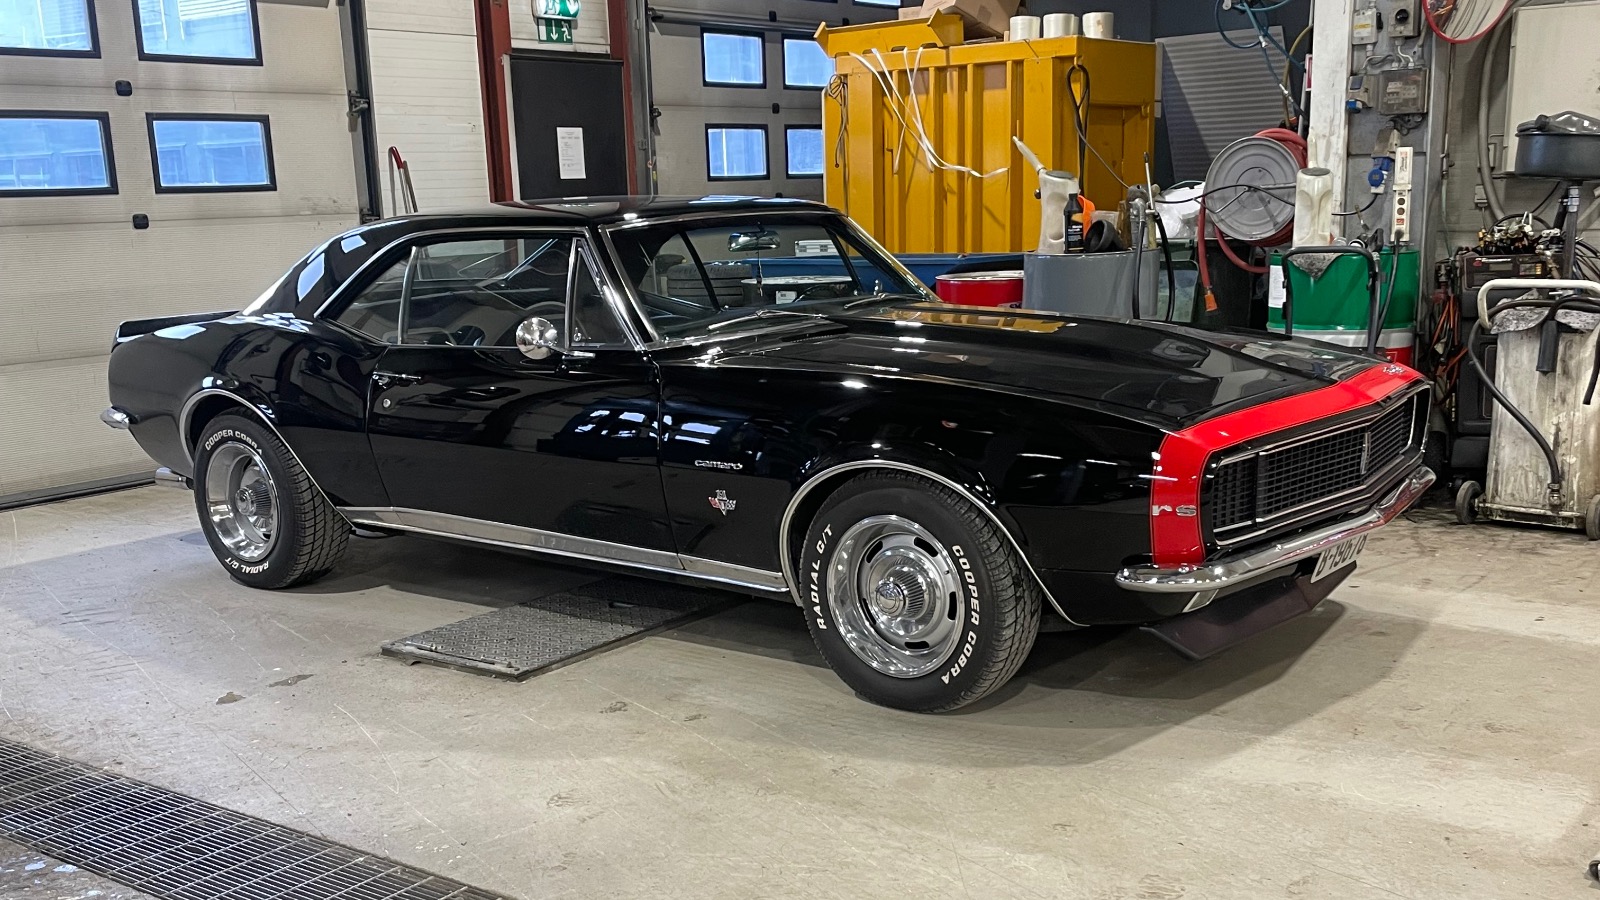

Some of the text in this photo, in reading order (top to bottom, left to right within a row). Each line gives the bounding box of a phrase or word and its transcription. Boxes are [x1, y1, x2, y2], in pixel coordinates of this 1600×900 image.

[204, 429, 262, 454] COOPER COBRA
[240, 560, 269, 574] RADIAL
[810, 559, 827, 630] RADIAL
[941, 545, 980, 685] COOPER COBRA
